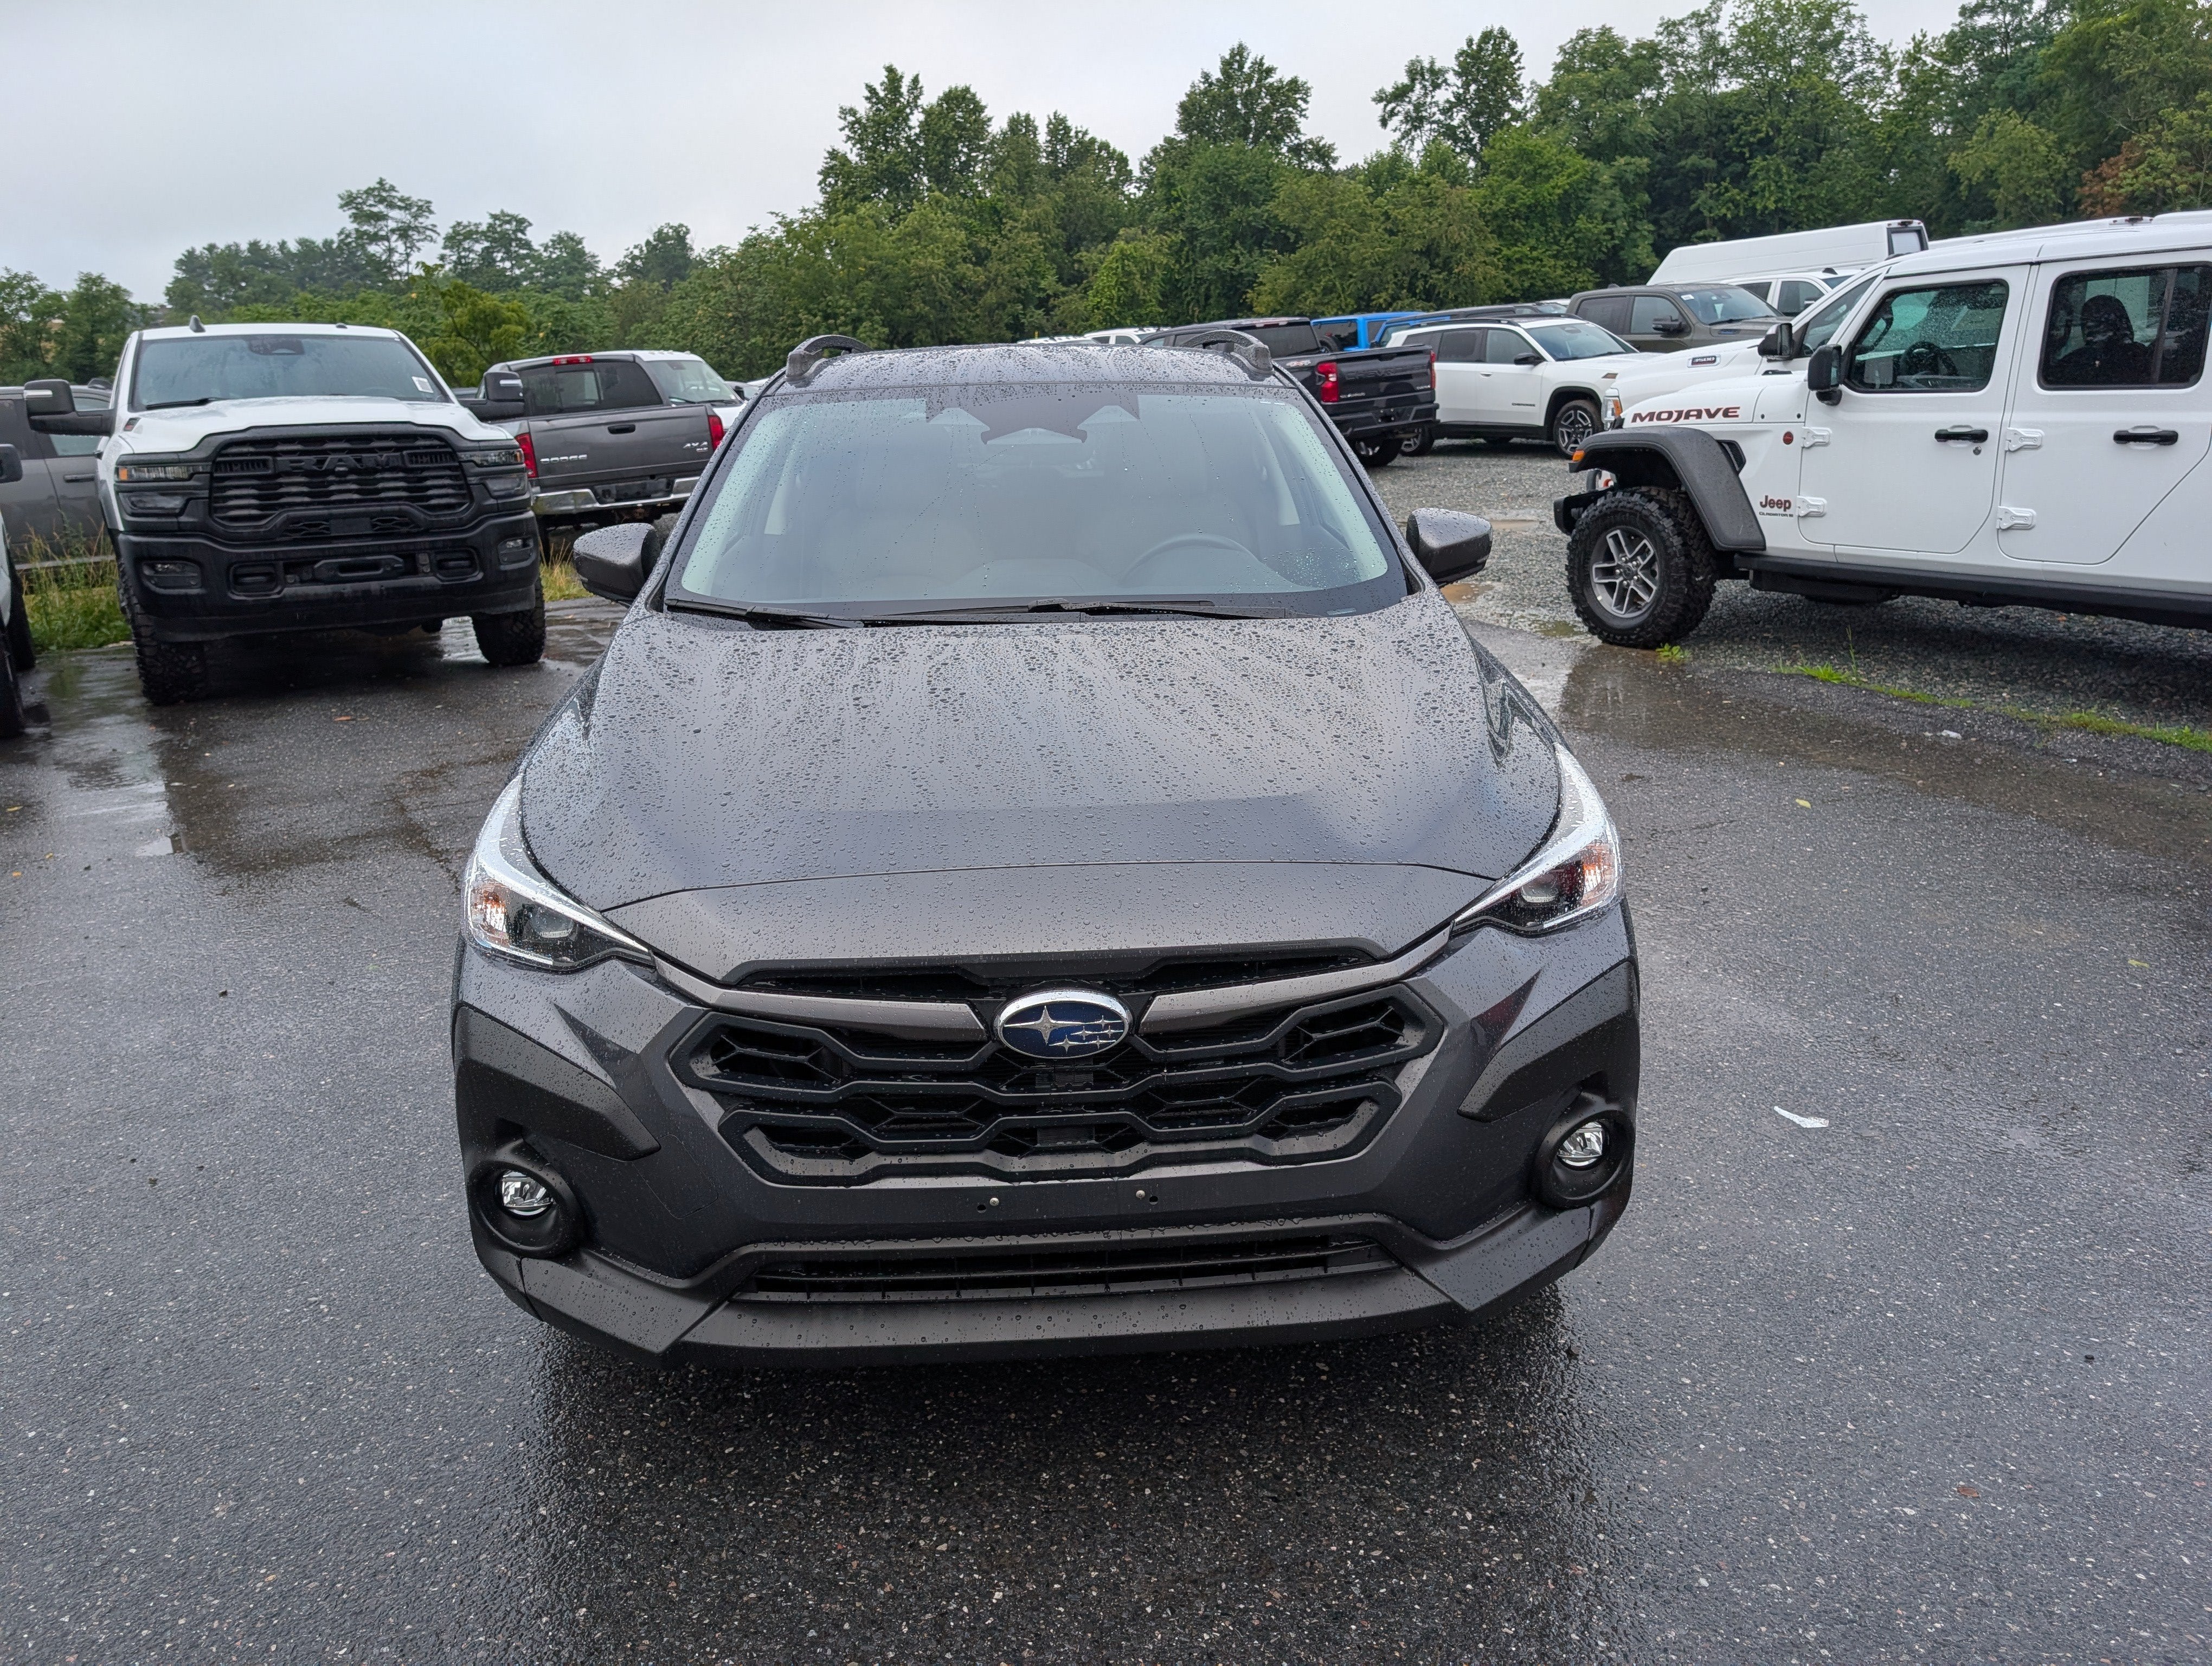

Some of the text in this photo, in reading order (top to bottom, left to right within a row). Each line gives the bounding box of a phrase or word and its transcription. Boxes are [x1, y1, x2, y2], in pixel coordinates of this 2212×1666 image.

[1631, 406, 1740, 424] MOJAVE
[273, 452, 403, 473] RAM
[540, 454, 587, 464] DODGE
[1759, 495, 1791, 511] Jeep
